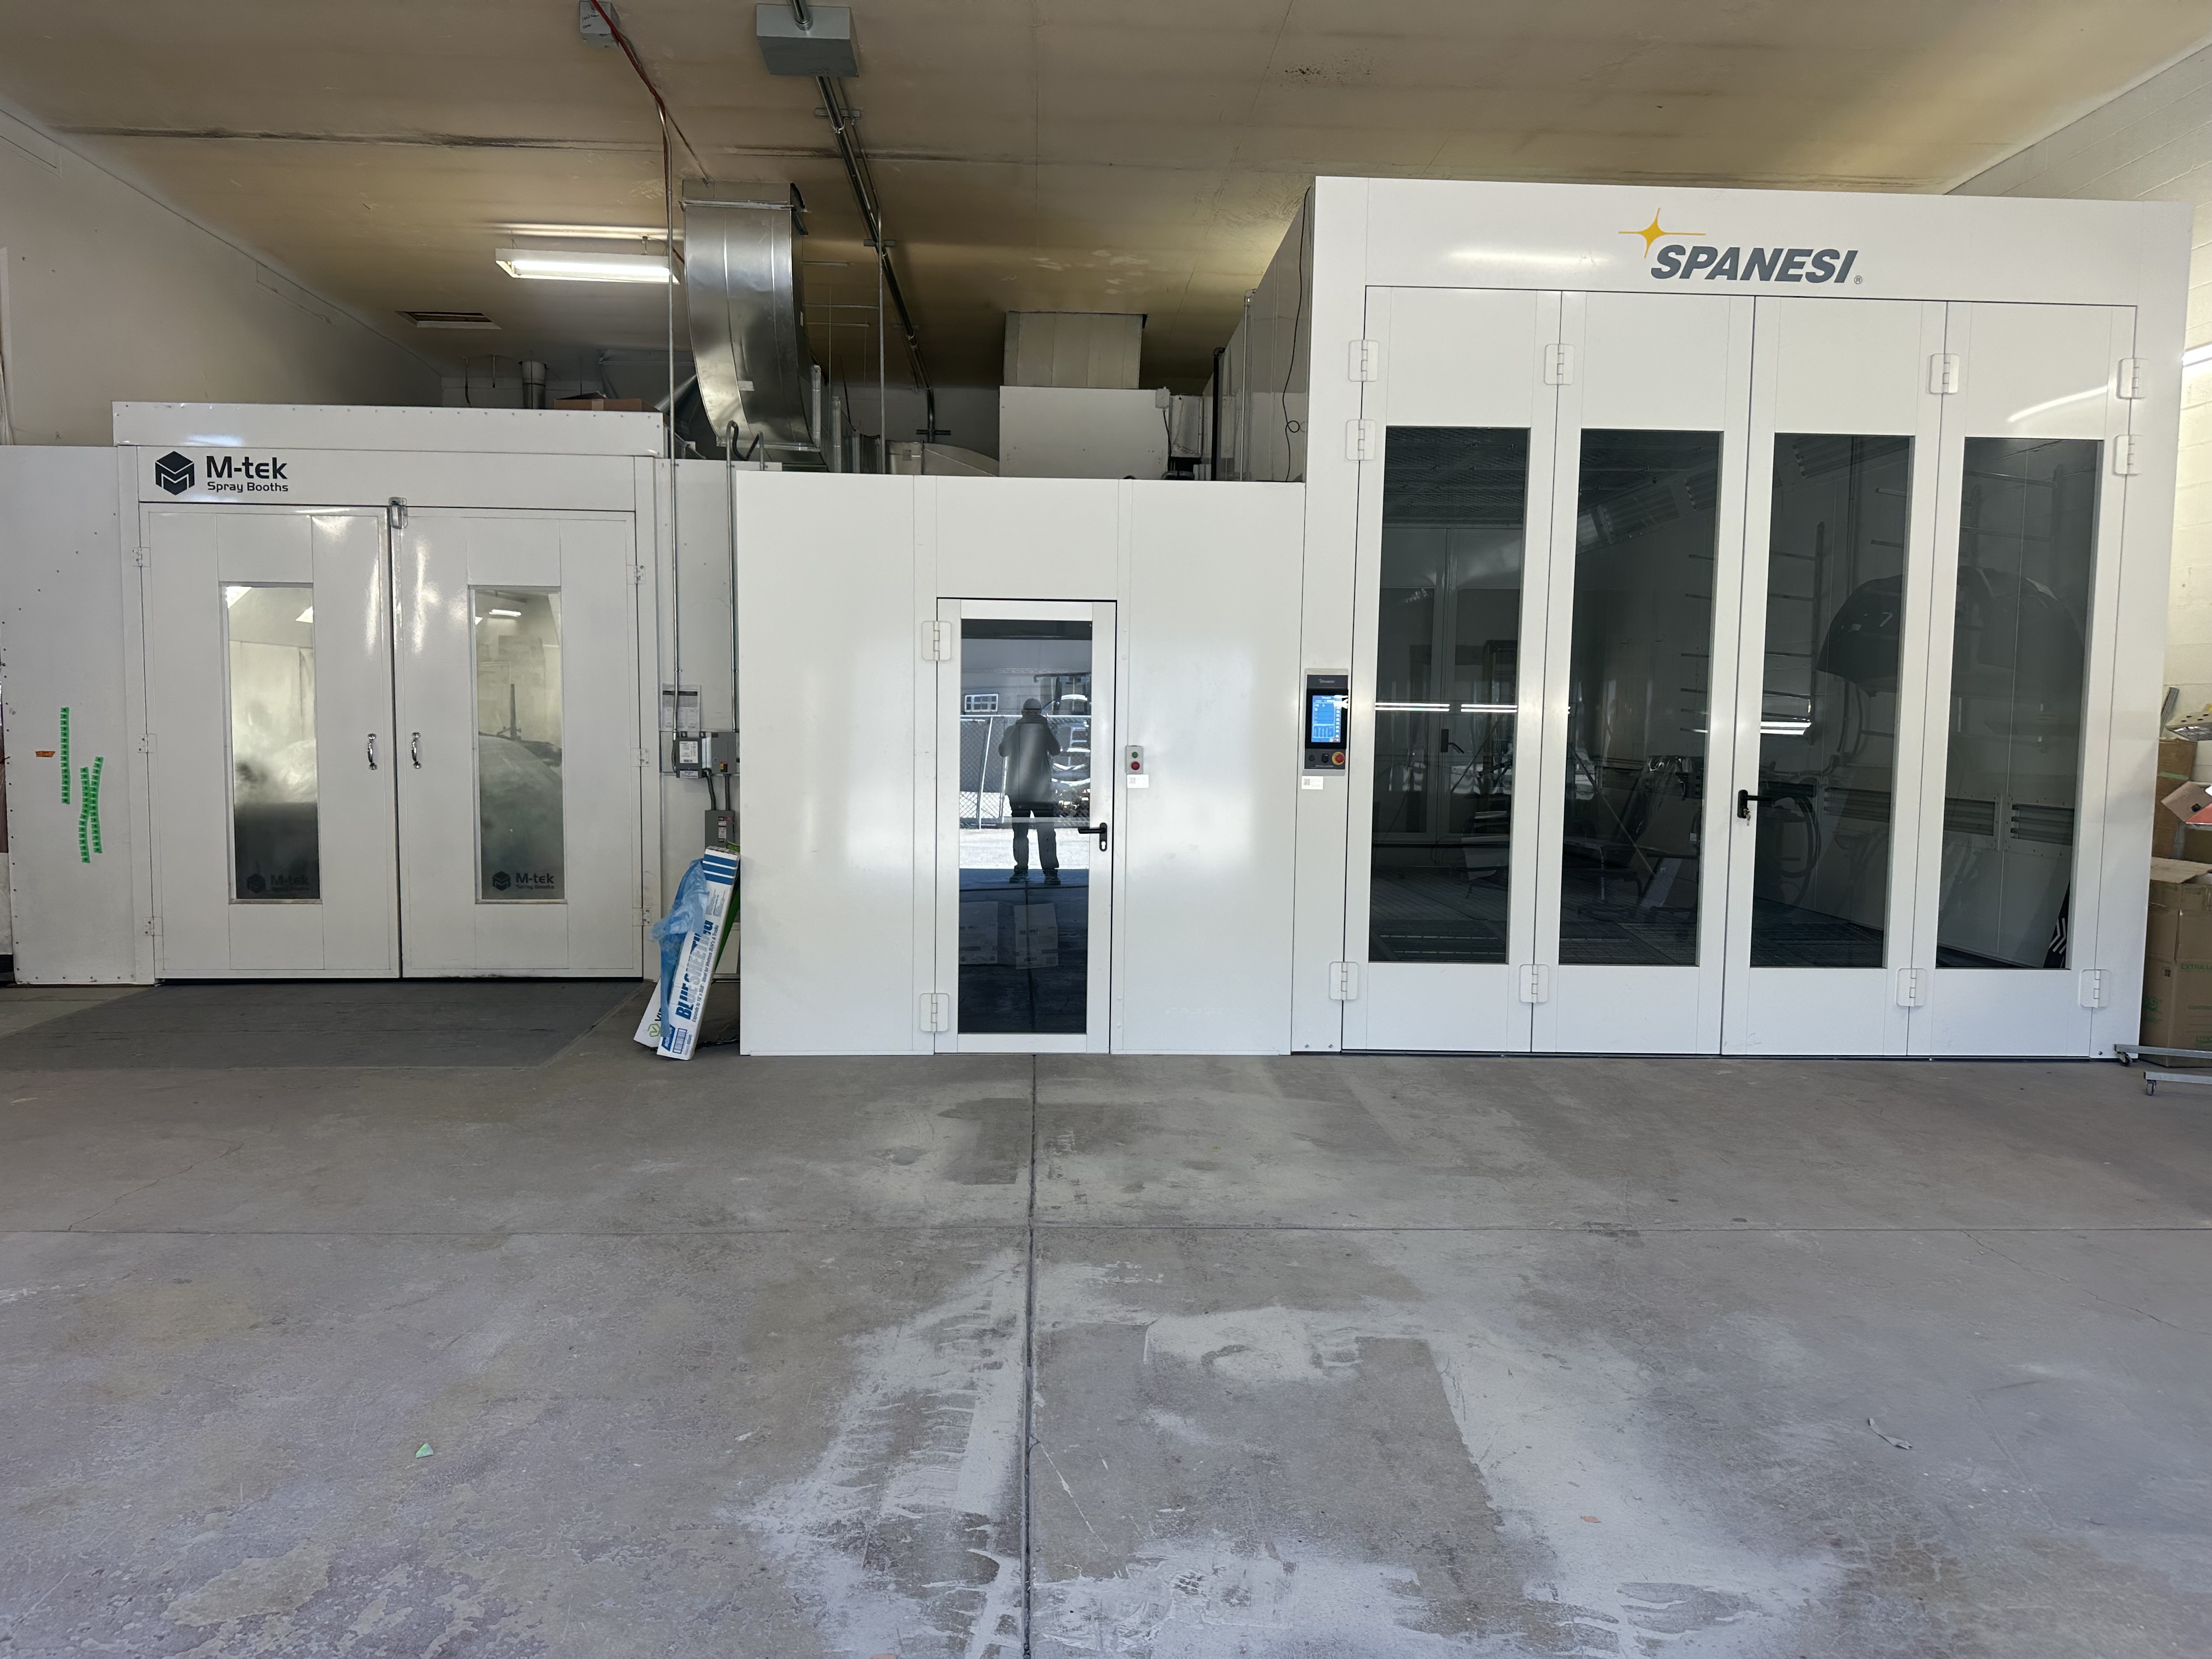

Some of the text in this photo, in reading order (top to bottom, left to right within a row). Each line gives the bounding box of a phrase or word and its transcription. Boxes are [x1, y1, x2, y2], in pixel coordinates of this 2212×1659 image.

[206, 455, 288, 479] M-tek
[207, 481, 289, 493] Spray Booths
[270, 874, 309, 885] M-tek
[516, 873, 554, 884] M-tek
[675, 983, 698, 1020] BLUE
